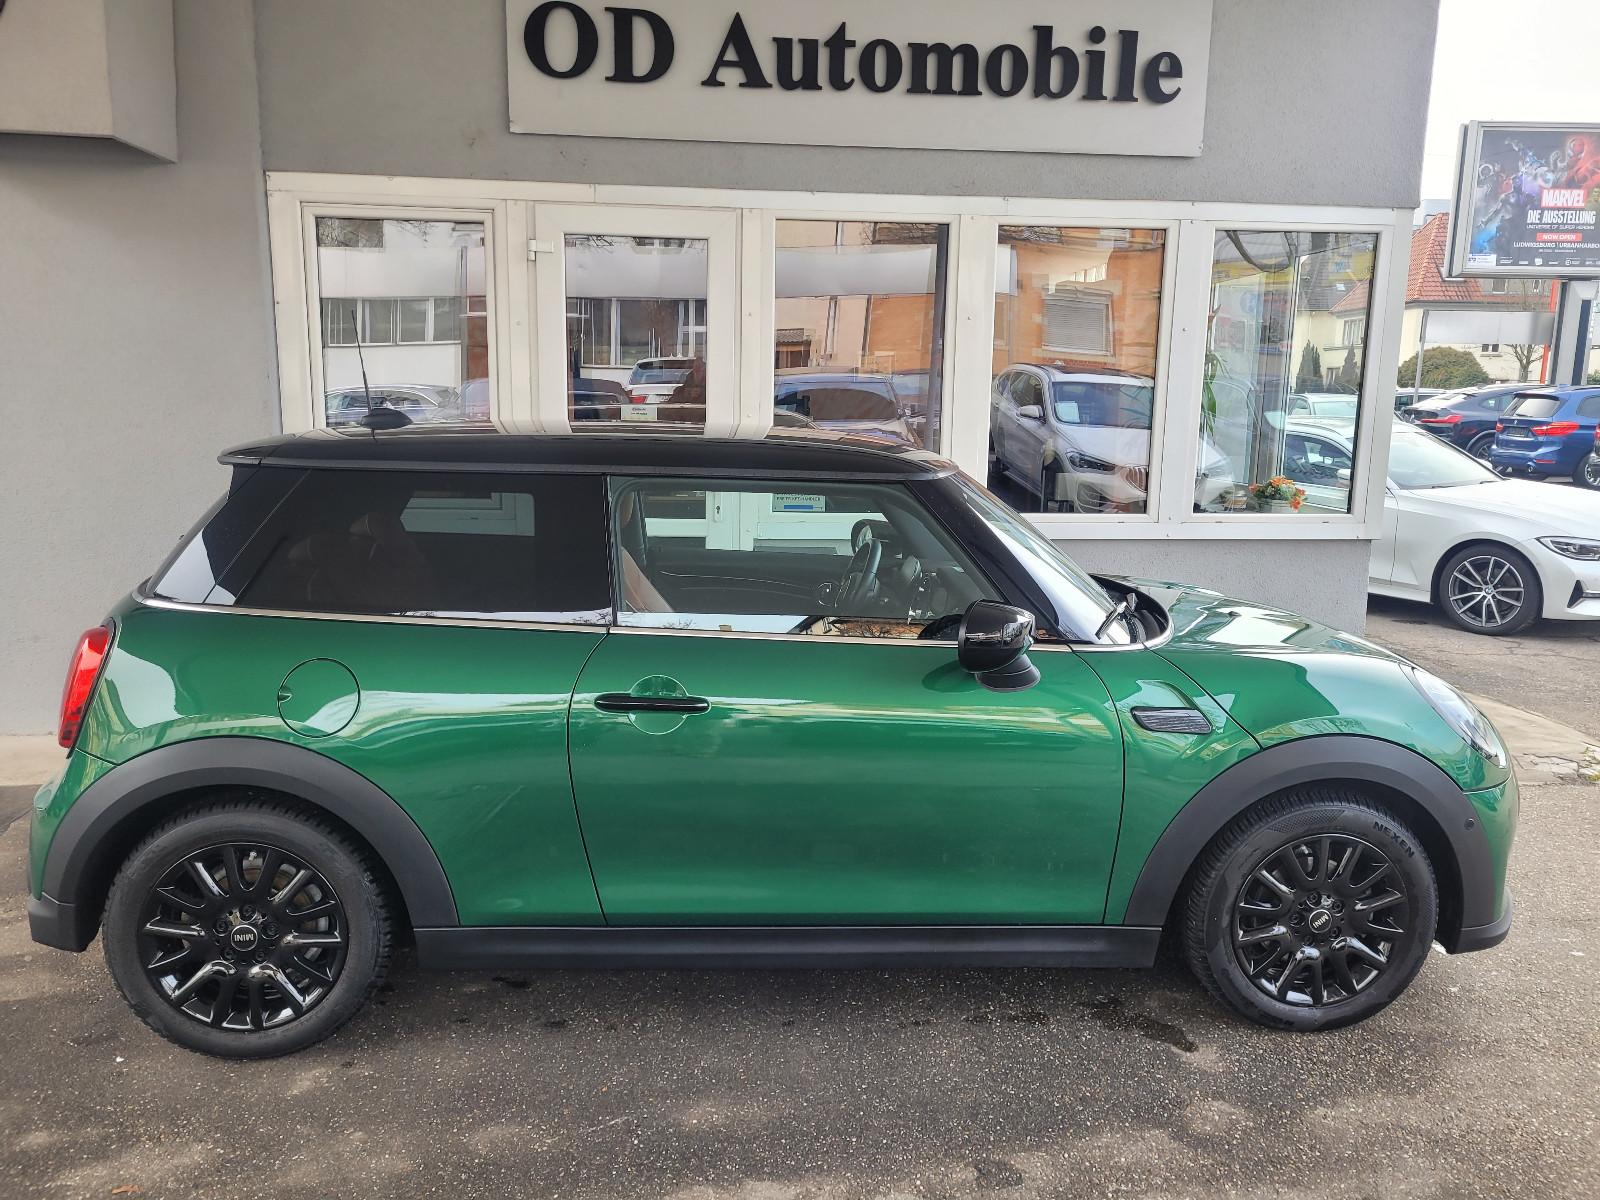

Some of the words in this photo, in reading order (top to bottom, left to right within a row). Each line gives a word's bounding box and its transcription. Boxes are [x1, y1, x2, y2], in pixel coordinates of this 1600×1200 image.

[523, 1, 675, 84] OD
[700, 12, 1184, 104] Automobile
[1541, 189, 1585, 207] MARVEL
[1527, 209, 1541, 224] DIE
[1542, 210, 1597, 224] AUSSTELLUNG
[1373, 820, 1415, 858] NEXEN
[1312, 913, 1329, 929] MINI
[234, 933, 254, 942] MINI
